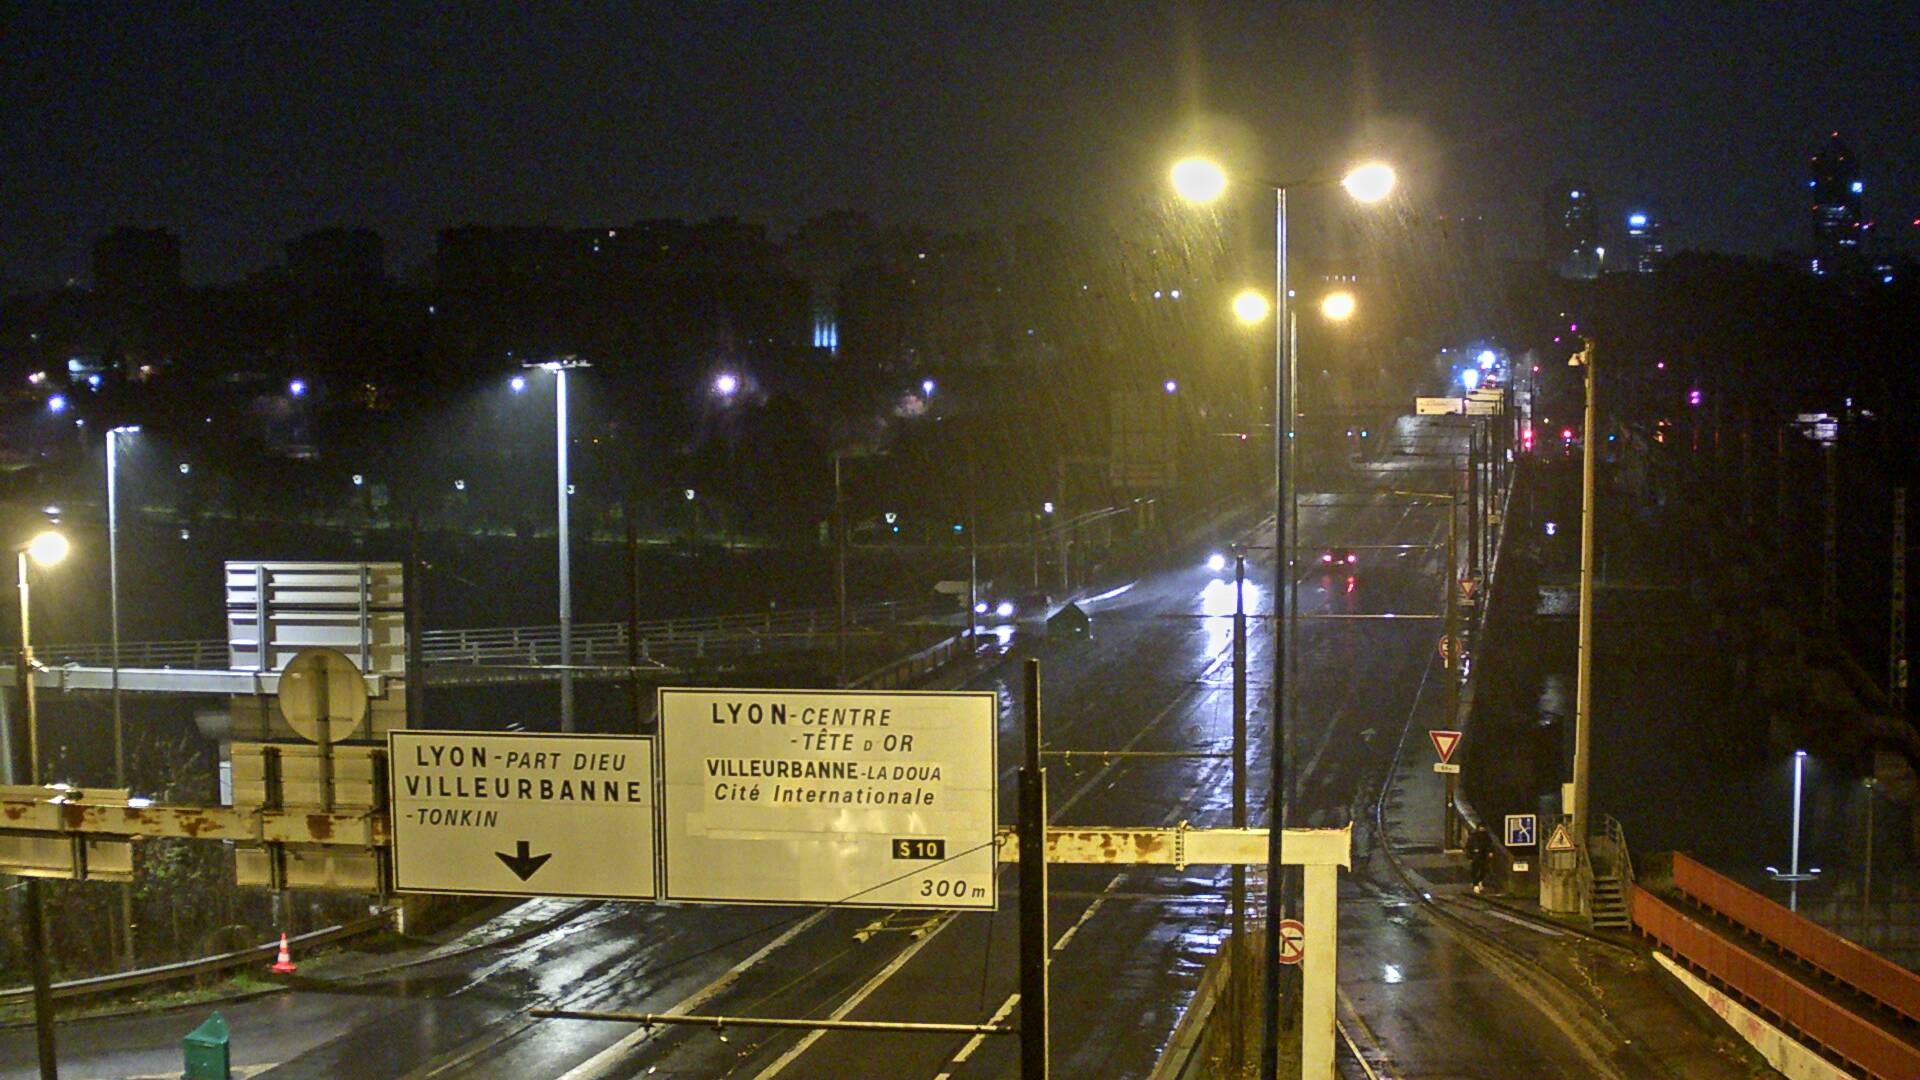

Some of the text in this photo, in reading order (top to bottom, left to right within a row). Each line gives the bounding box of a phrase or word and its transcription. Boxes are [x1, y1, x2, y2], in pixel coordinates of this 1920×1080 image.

[573, 752, 626, 772] DIEU
[893, 765, 941, 781] DOUA
[405, 774, 641, 803] VILLEURBANNE
[714, 782, 935, 806] Cité Internationale
[406, 808, 498, 828] -TONKIN
